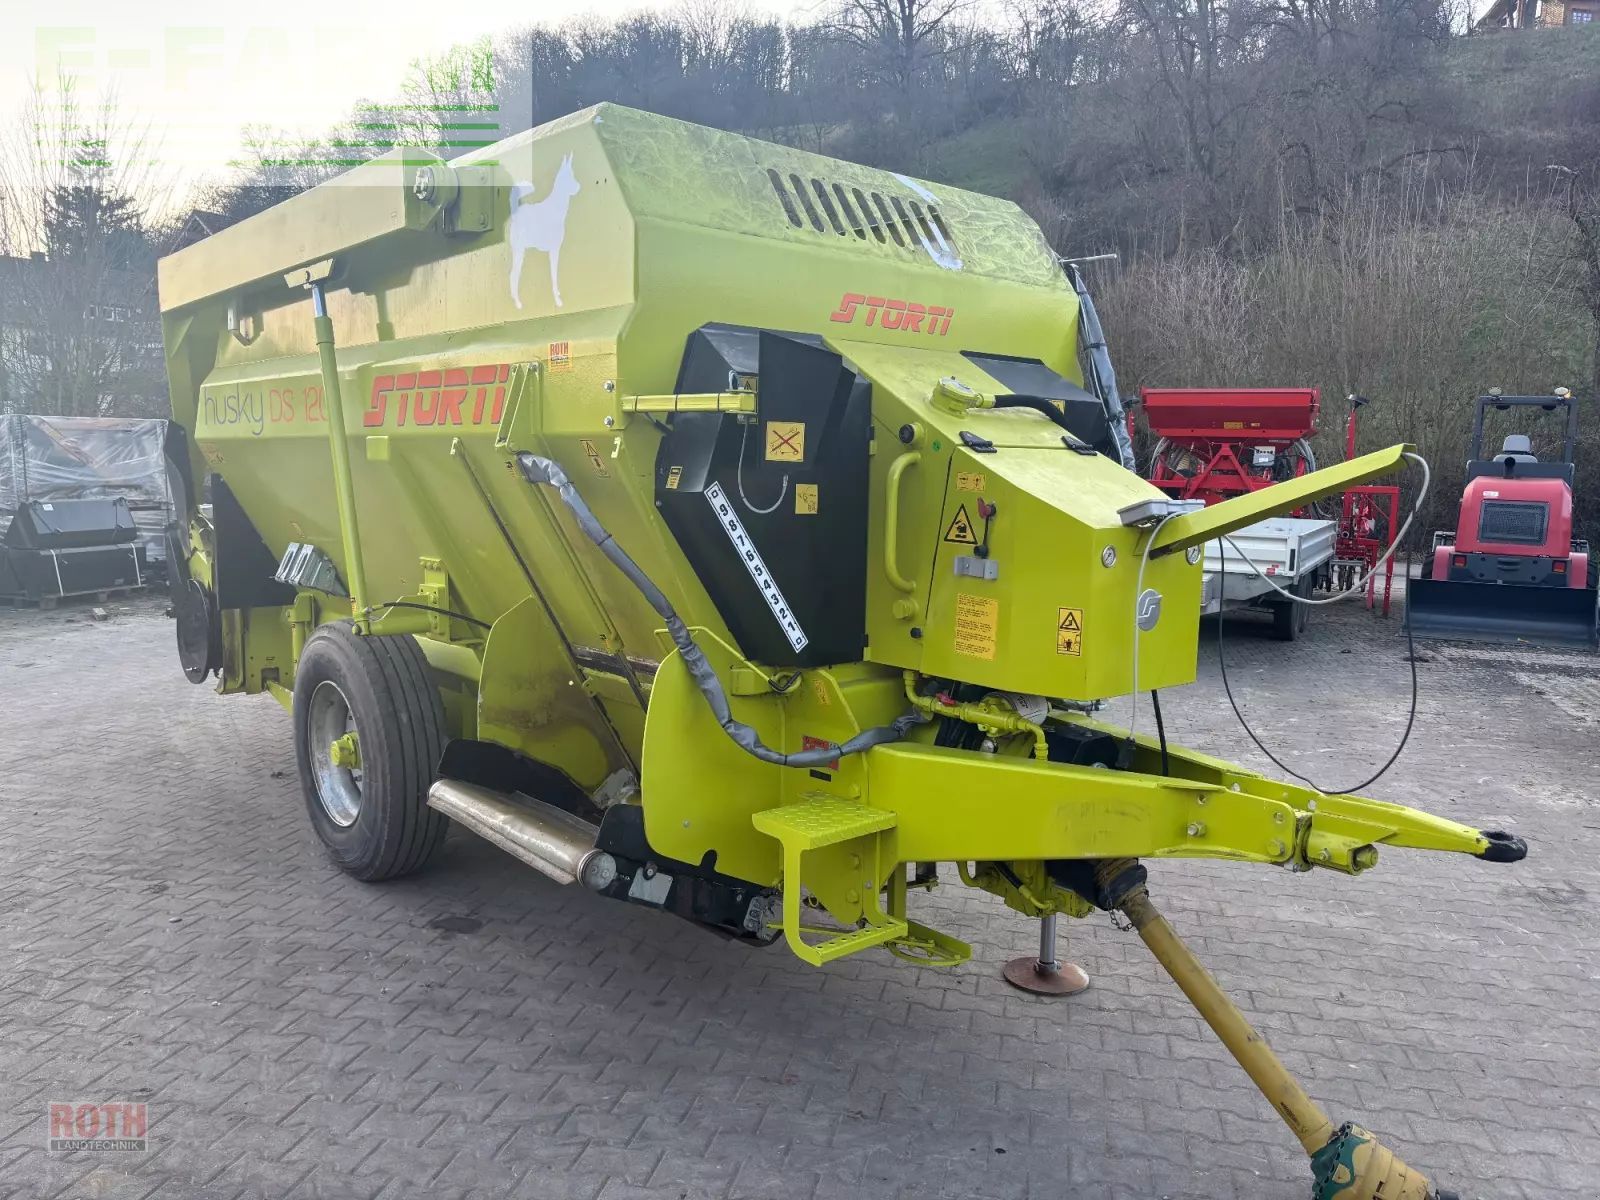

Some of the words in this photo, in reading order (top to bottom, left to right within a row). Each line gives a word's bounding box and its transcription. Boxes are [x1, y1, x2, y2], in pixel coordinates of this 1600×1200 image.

[830, 293, 955, 336] STORTI
[550, 341, 569, 356] ROTH
[204, 383, 264, 436] husky
[269, 388, 295, 422] DS
[363, 363, 510, 427] STORTI
